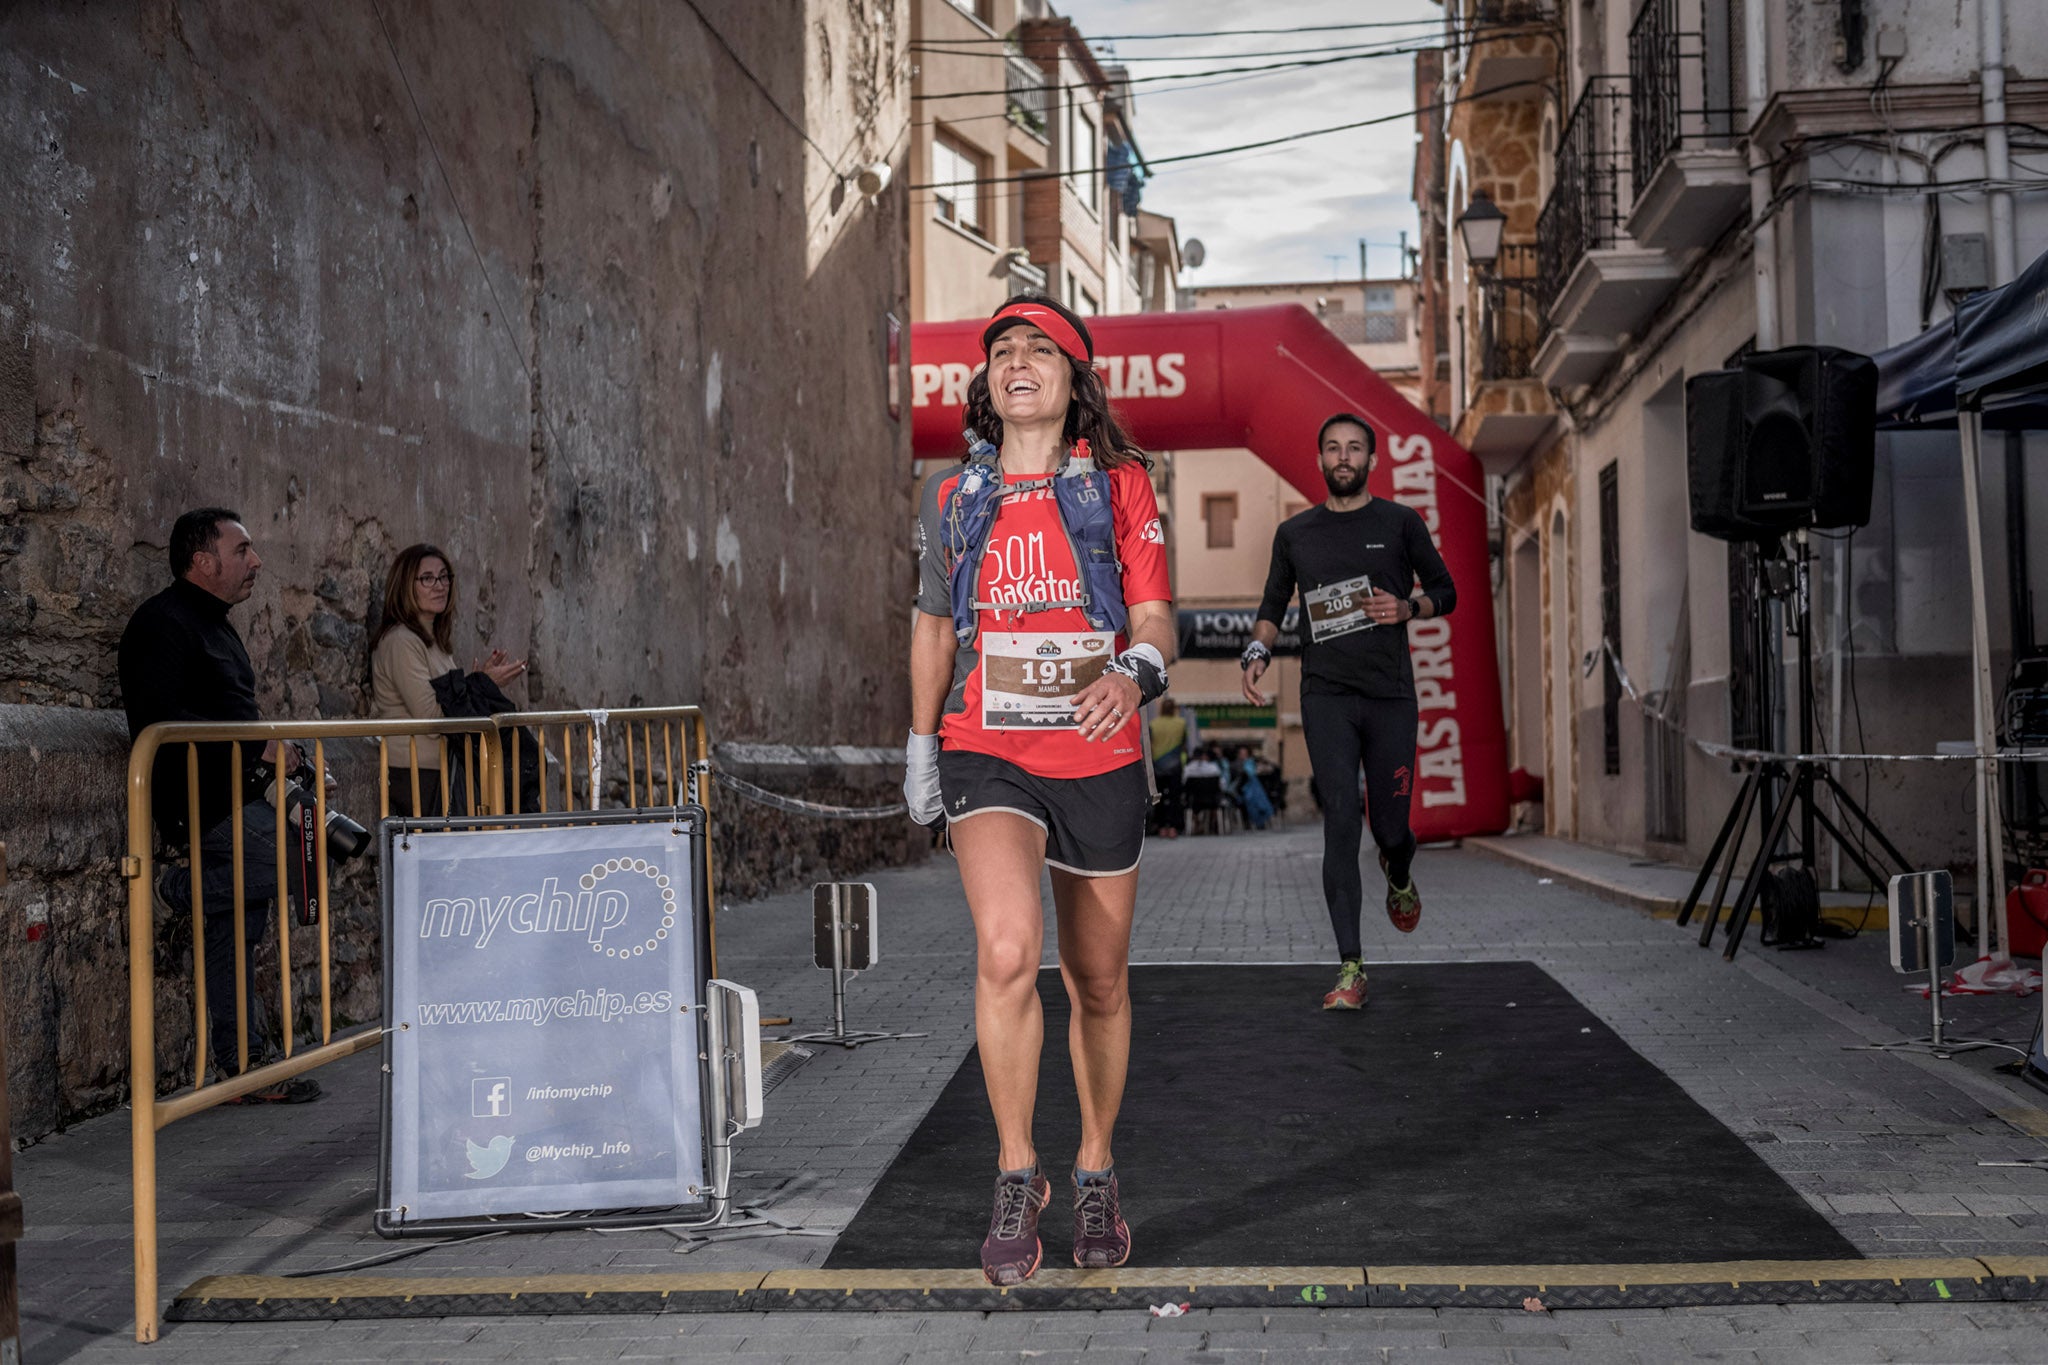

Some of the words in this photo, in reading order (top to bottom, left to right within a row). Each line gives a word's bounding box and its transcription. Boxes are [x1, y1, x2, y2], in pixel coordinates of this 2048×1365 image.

[910, 353, 1187, 407] PRIAS
[986, 531, 1047, 585] SOM
[1388, 433, 1458, 712] PROIAS
[1324, 596, 1353, 614] 206
[1022, 661, 1076, 684] 191
[1416, 716, 1467, 809] LAS
[304, 808, 313, 829] EOS
[305, 831, 314, 842] 5D
[420, 877, 629, 949] mychip
[418, 989, 672, 1026] www.mychip.es
[526, 1083, 613, 1101] /infomychip
[525, 1141, 631, 1163] @Mychip_Info
